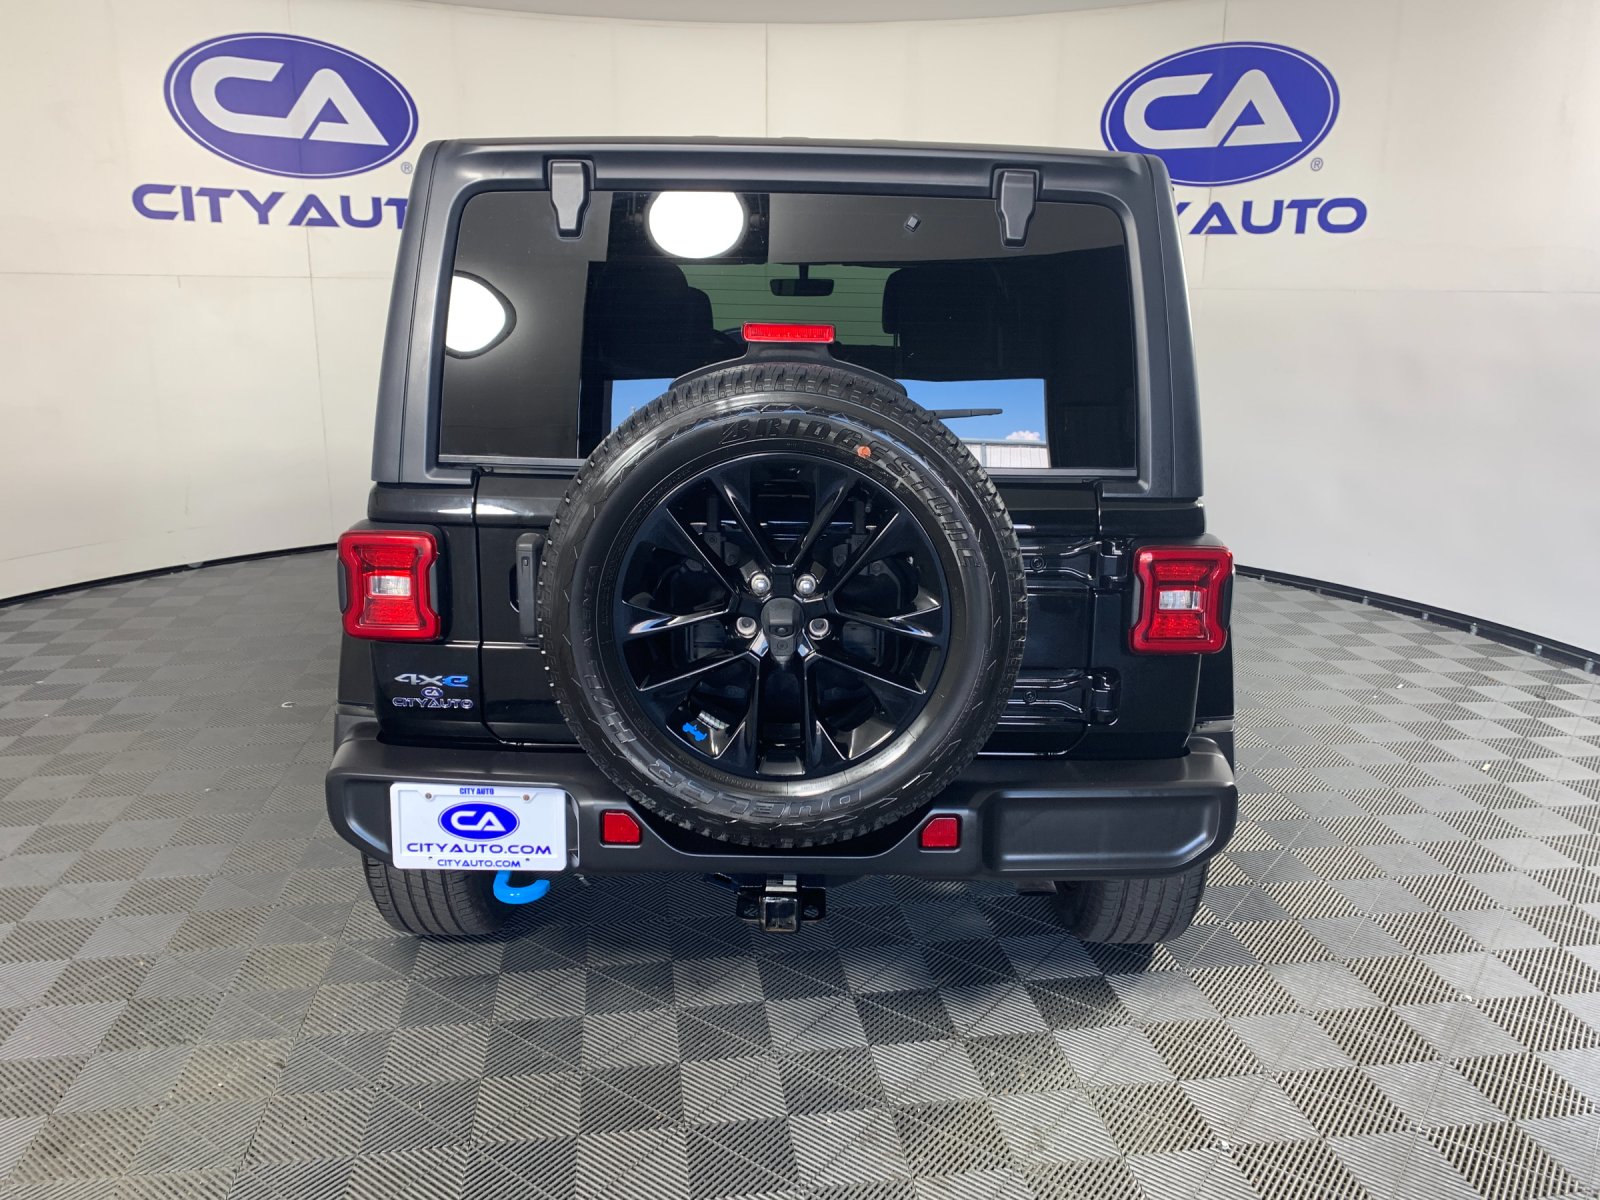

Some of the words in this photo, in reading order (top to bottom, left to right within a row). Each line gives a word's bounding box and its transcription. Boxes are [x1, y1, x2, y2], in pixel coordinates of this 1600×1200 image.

[190, 55, 389, 146] CA
[1123, 68, 1303, 150] CA
[131, 183, 409, 230] CITYAUT
[720, 416, 982, 568] BRIDGESTONE
[423, 688, 440, 697] CA
[459, 787, 475, 796] CITY
[476, 787, 495, 796] AUTO
[649, 758, 862, 819] DUELER
[450, 810, 506, 832] CA
[406, 843, 552, 855] CITYAUTO.COM
[437, 859, 521, 868] CITYAUTO.COM
